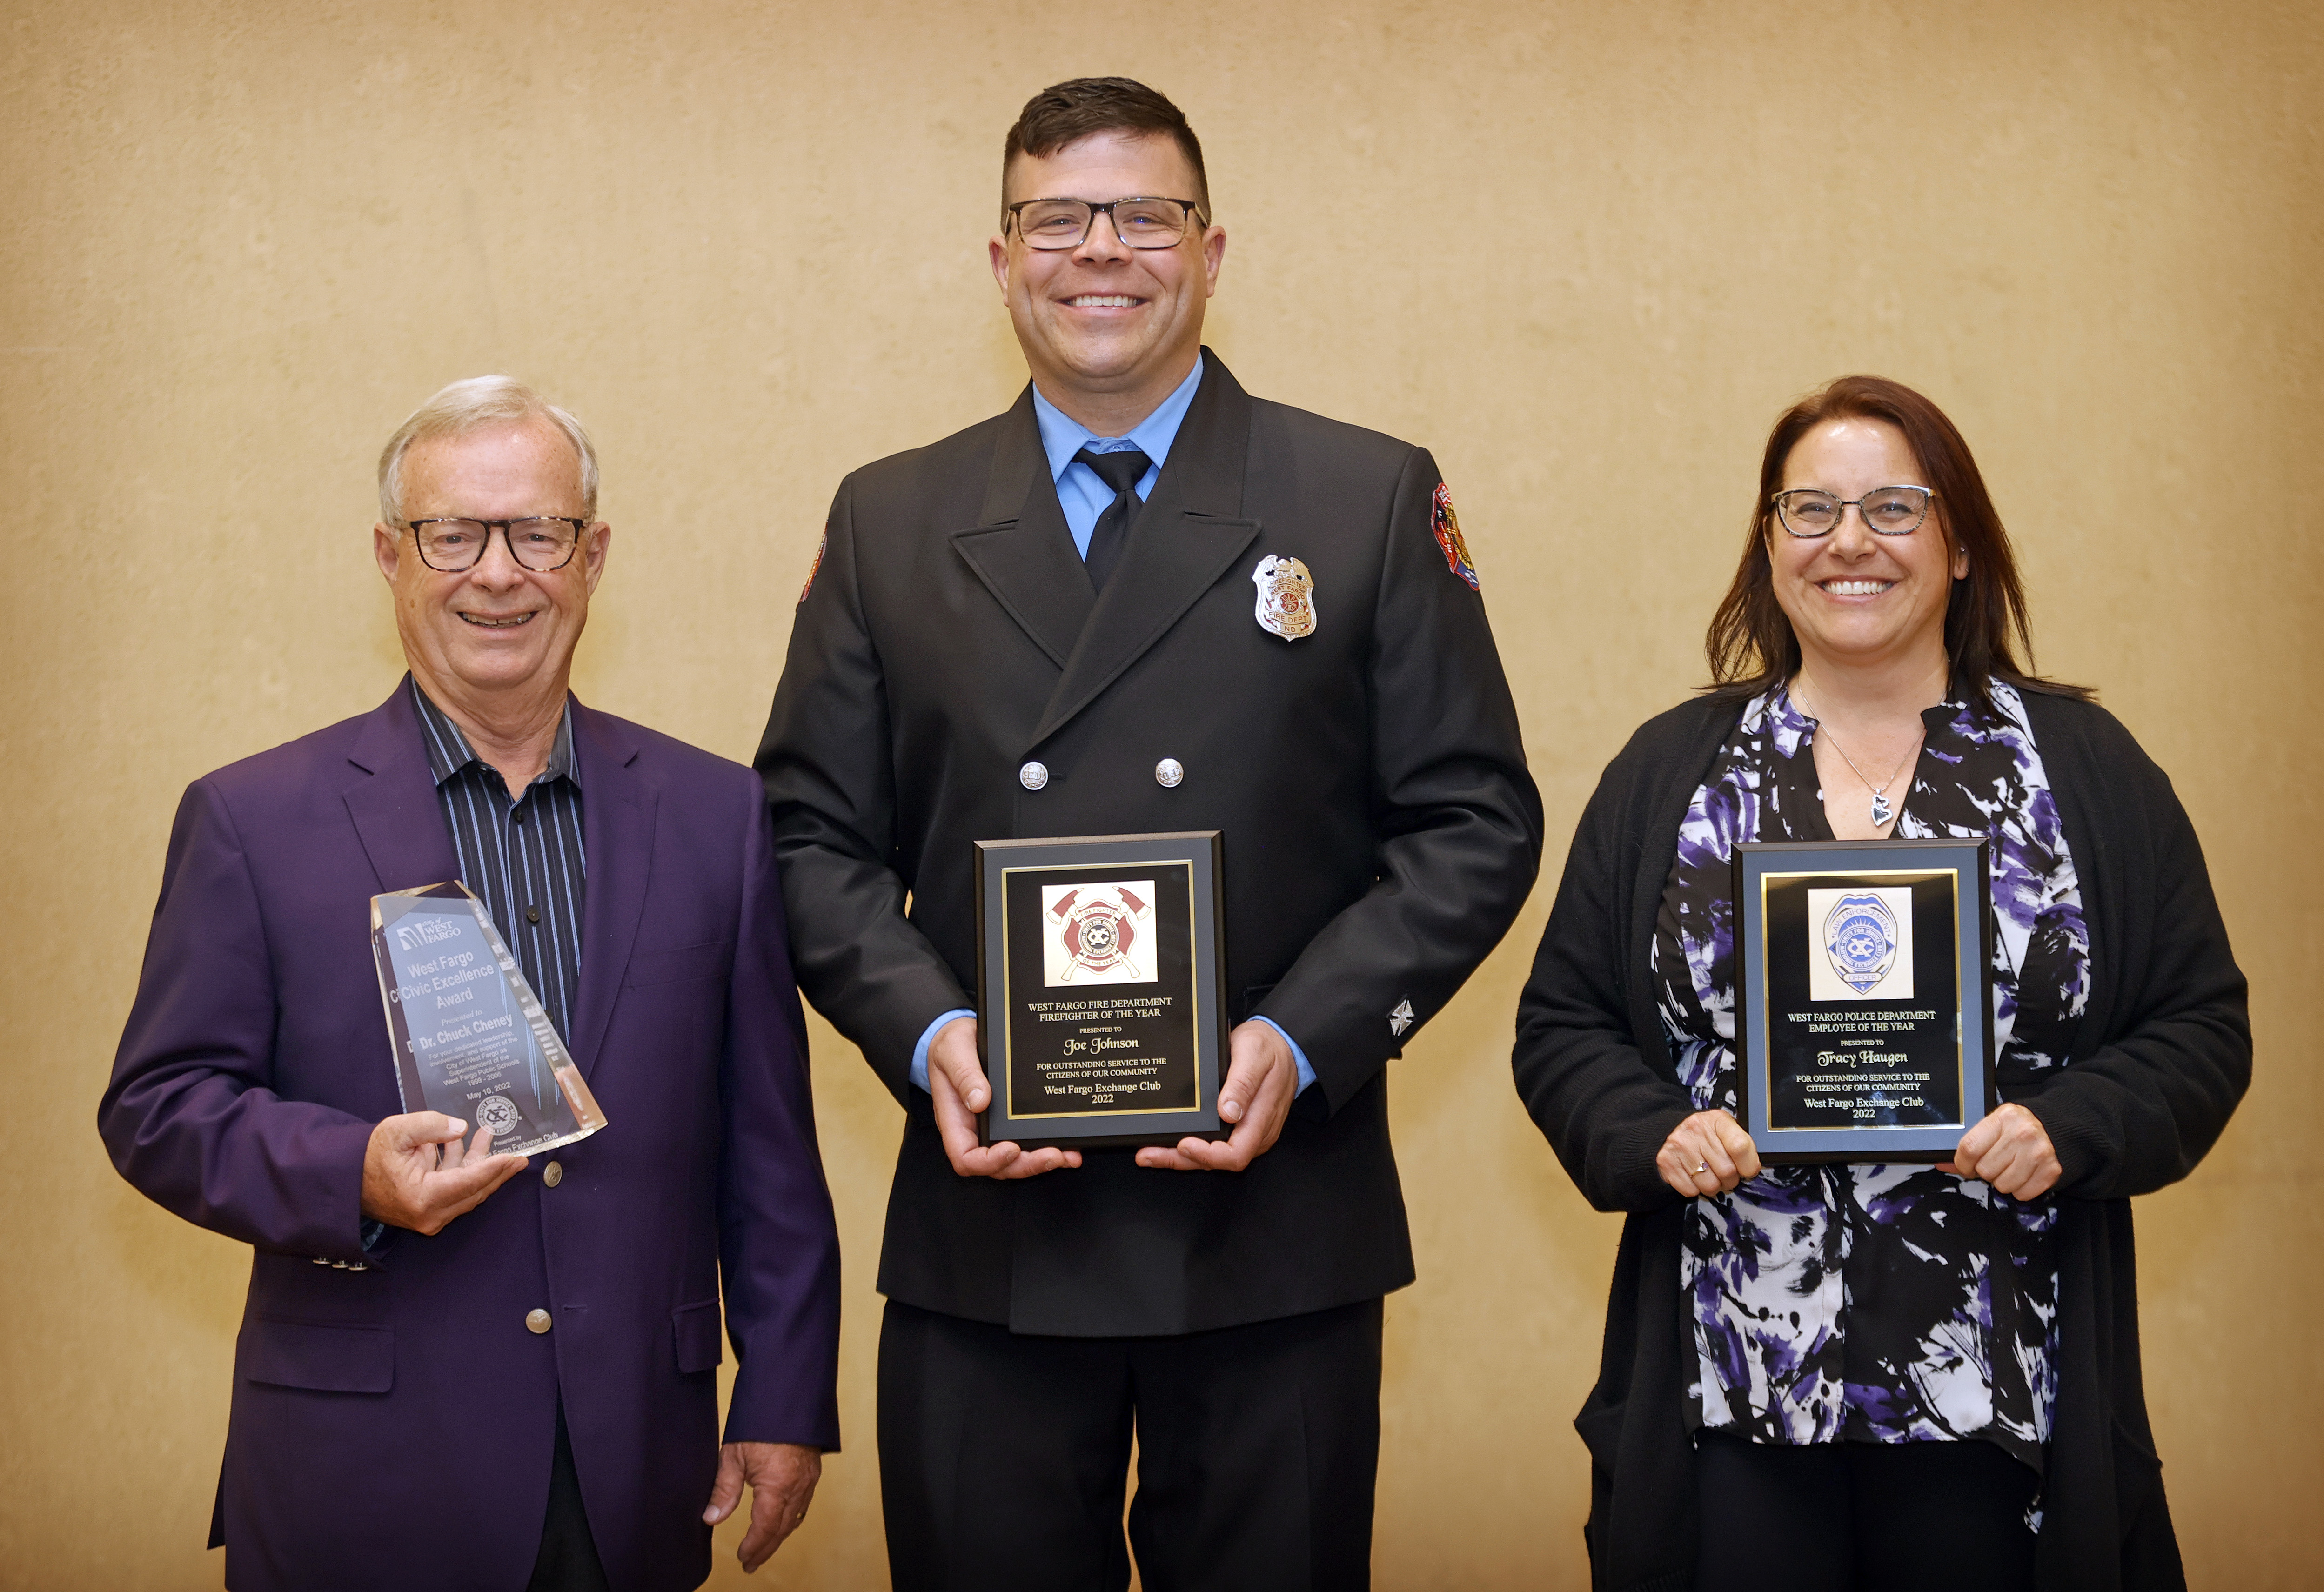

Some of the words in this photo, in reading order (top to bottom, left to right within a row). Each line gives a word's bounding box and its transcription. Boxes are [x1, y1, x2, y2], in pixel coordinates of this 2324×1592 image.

[1270, 579, 1306, 589] FIREFIGHTER
[1271, 586, 1285, 595] WEST
[1287, 586, 1305, 599] FARGO
[1269, 612, 1286, 622] FIRE
[424, 921, 452, 936] WEST
[1832, 918, 1842, 936] LAW
[1842, 908, 1891, 934] ENFORCEMENT
[427, 927, 462, 943] FARGO
[1841, 930, 1854, 944] UNITY
[1866, 928, 1881, 942] SERVICE
[1840, 945, 1854, 966] NATIONAL
[1854, 956, 1878, 968] EXCHANGE
[407, 960, 440, 978] West
[439, 951, 474, 970] Fargo
[401, 983, 431, 1000] Civic
[432, 964, 494, 991] Excellence
[436, 987, 473, 1009] Award
[1028, 1003, 1054, 1012] WEST
[1056, 1001, 1086, 1010] FARGO
[1088, 1000, 1109, 1009] FIRE
[1111, 997, 1172, 1008] DEPARTMENT
[442, 1010, 474, 1026] Presented
[1039, 1011, 1099, 1022] FIREFIGHTER
[1100, 1010, 1113, 1019] OF
[1115, 1010, 1133, 1018] THE
[1135, 1008, 1161, 1017] YEAR
[1788, 1013, 1812, 1022] WEST
[1814, 1012, 1843, 1022] FARGO
[1845, 1011, 1876, 1021] POLICE
[1877, 1010, 1936, 1020] DEPARTMENT
[419, 1037, 436, 1050] Dr.
[437, 1025, 473, 1044] Chuck
[473, 1014, 512, 1033] Cheney
[1808, 1023, 1857, 1033] EMPLOYEE
[1857, 1023, 1870, 1032] OF
[1871, 1022, 1889, 1031] THE
[1891, 1022, 1915, 1031] YEAR
[454, 1039, 482, 1052] dedicated
[479, 1042, 501, 1053] support
[1063, 1039, 1087, 1056] Joe
[1090, 1037, 1139, 1055] Johnson
[465, 1055, 481, 1064] West
[482, 1050, 499, 1059] Fargo
[1817, 1050, 1857, 1068] Tracy
[1859, 1050, 1908, 1067] Haugen
[443, 1077, 459, 1086] West
[459, 1072, 477, 1082] Fargo
[477, 1067, 496, 1075] Public
[496, 1059, 520, 1070] Schools
[449, 1059, 492, 1077] Superintendent
[1053, 1061, 1106, 1070] OUTSTANDING
[1046, 1071, 1080, 1079] CITIZENS
[1110, 1068, 1158, 1077] COMMUNITY
[1813, 1074, 1868, 1082] OUTSTANDING
[466, 1091, 481, 1100] May
[494, 1082, 511, 1092] 2022
[1044, 1086, 1066, 1095] West
[1067, 1085, 1093, 1095] Fargo
[1095, 1083, 1138, 1093] Exchange
[1139, 1081, 1161, 1090] Club
[1806, 1084, 1841, 1092] CITIZENS
[1871, 1082, 1921, 1091] COMMUNITY
[1092, 1094, 1114, 1104] 2022
[1803, 1097, 1827, 1108] West
[1828, 1097, 1854, 1110] Fargo
[1856, 1097, 1901, 1109] Exchange
[1902, 1096, 1924, 1106] Club
[1852, 1108, 1876, 1118] 2022
[494, 1136, 516, 1147] Presented
[543, 1131, 558, 1142] Club
